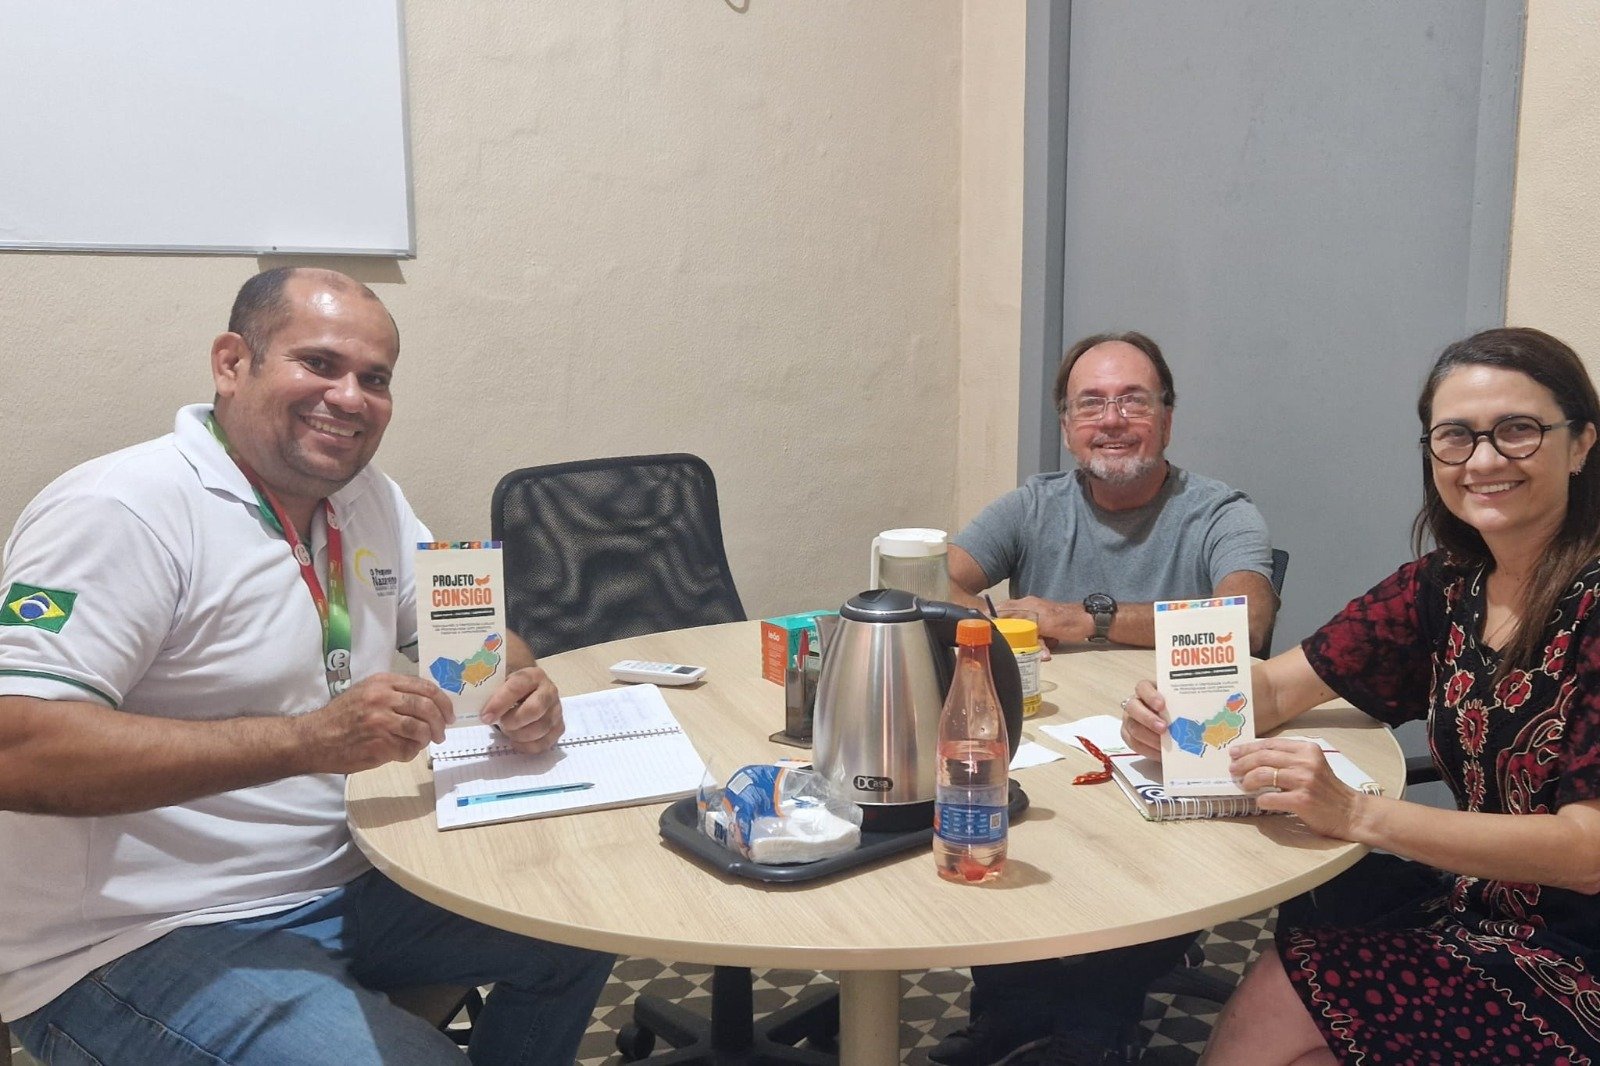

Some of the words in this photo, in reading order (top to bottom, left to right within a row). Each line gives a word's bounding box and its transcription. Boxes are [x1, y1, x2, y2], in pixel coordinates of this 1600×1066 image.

[432, 574, 475, 588] PROJETO
[432, 588, 492, 607] CONSIGO
[1172, 632, 1216, 647] PROJETO
[1171, 645, 1235, 667] CONSIGO
